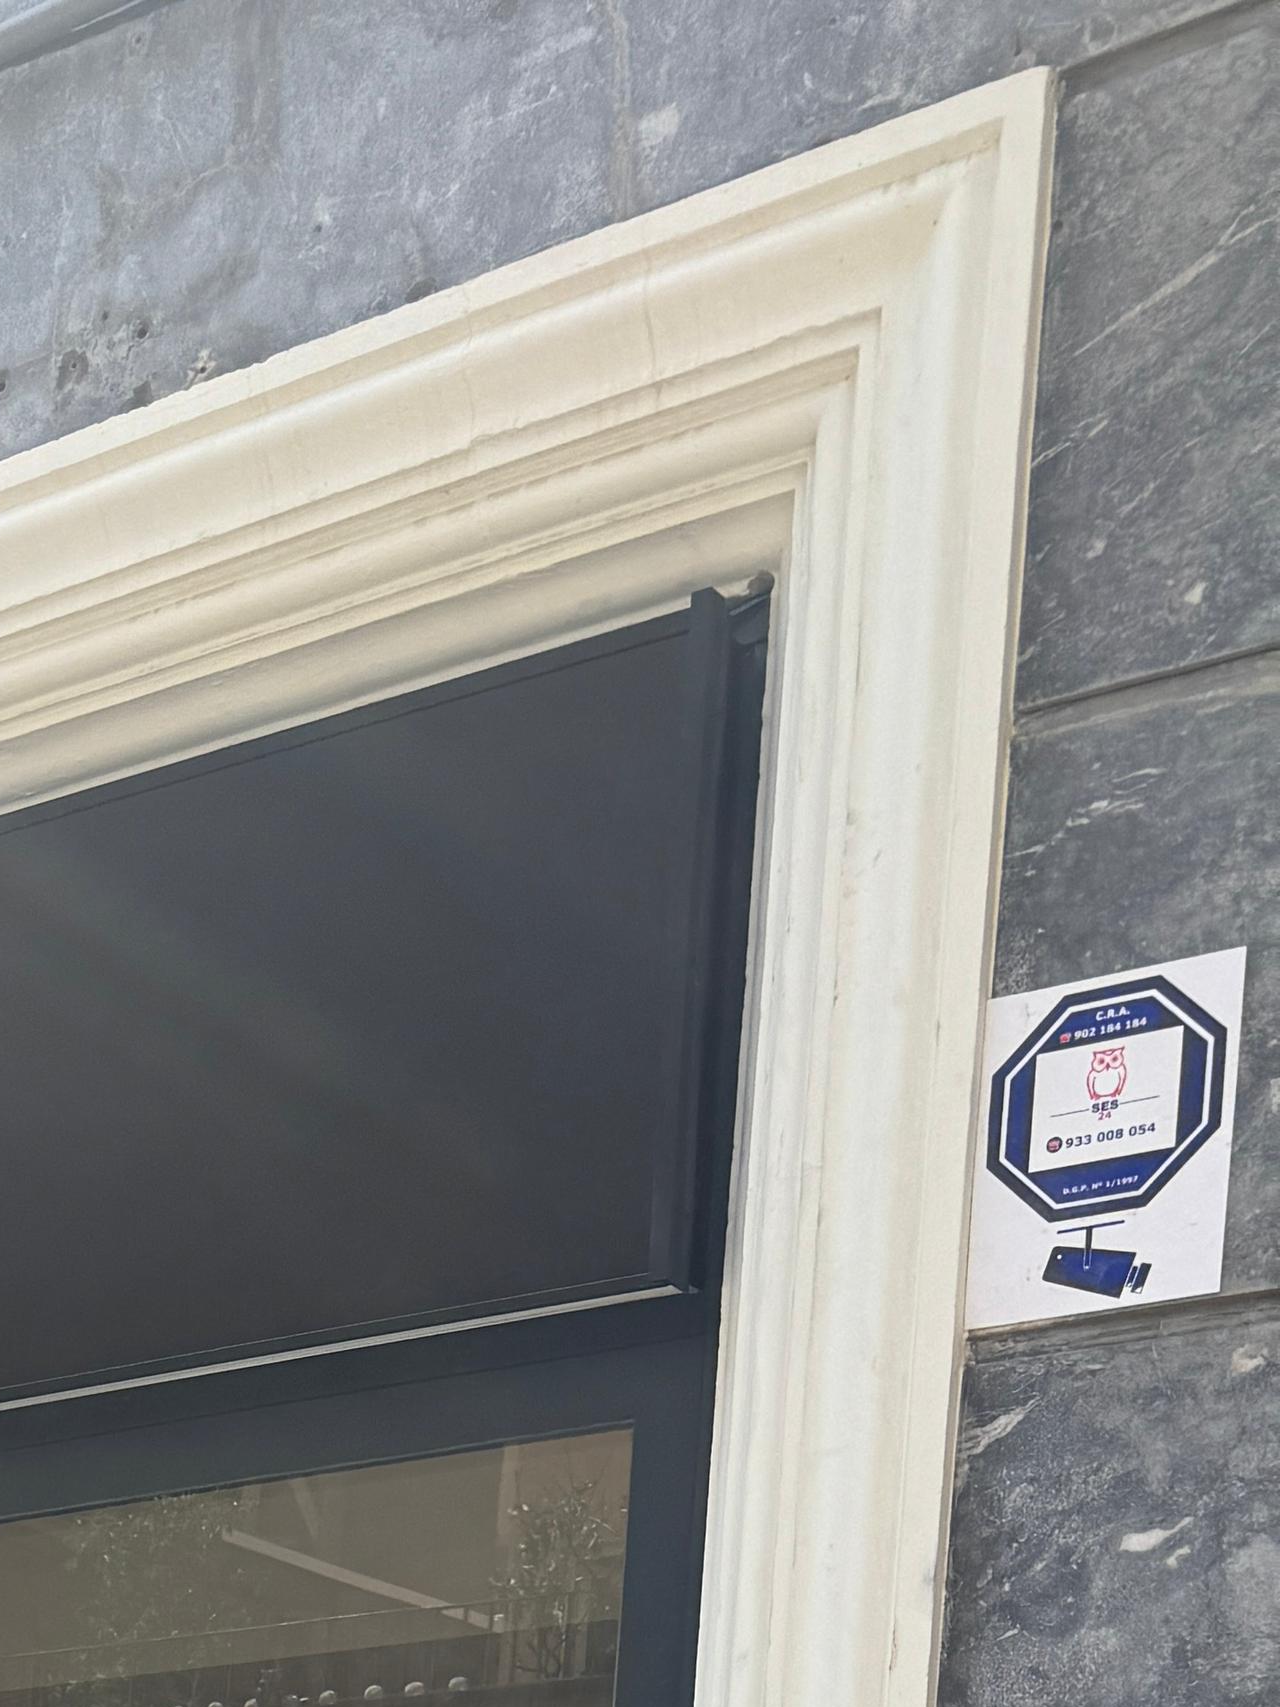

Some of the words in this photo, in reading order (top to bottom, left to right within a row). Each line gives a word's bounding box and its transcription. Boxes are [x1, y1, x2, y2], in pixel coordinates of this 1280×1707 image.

[1095, 1006, 1131, 1021] C.R.A.
[1074, 1027, 1096, 1040] 902
[1100, 1022, 1121, 1035] 184
[1125, 1016, 1147, 1029] 184
[1091, 1099, 1119, 1113] SES
[1098, 1111, 1112, 1121] 24
[1065, 1134, 1092, 1148] 933
[1097, 1128, 1124, 1143] 008
[1128, 1122, 1156, 1137] 054
